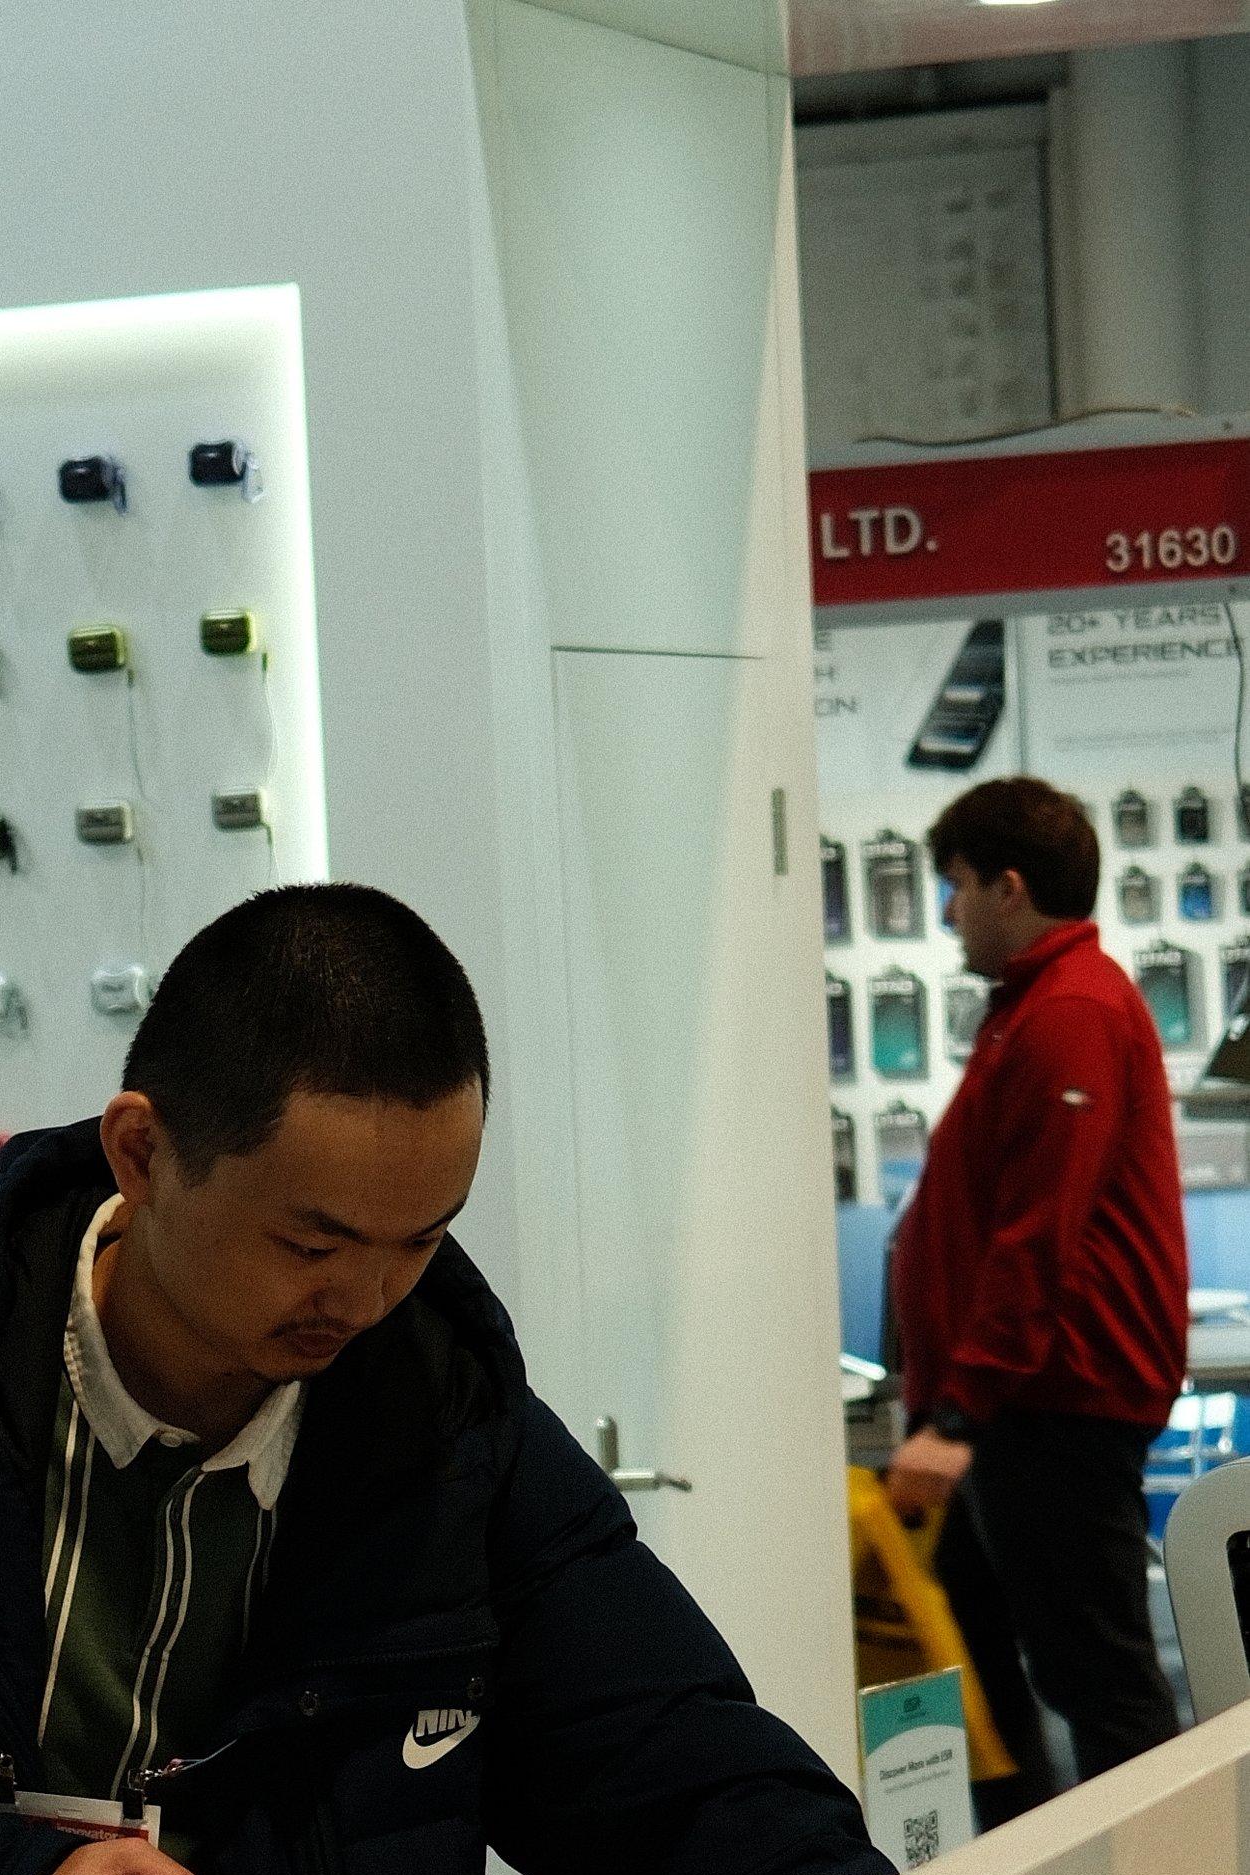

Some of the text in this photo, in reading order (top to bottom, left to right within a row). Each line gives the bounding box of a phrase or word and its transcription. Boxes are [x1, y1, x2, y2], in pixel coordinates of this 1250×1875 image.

[820, 506, 1237, 572] LTD. 31630
[1115, 606, 1220, 629] YEARS
